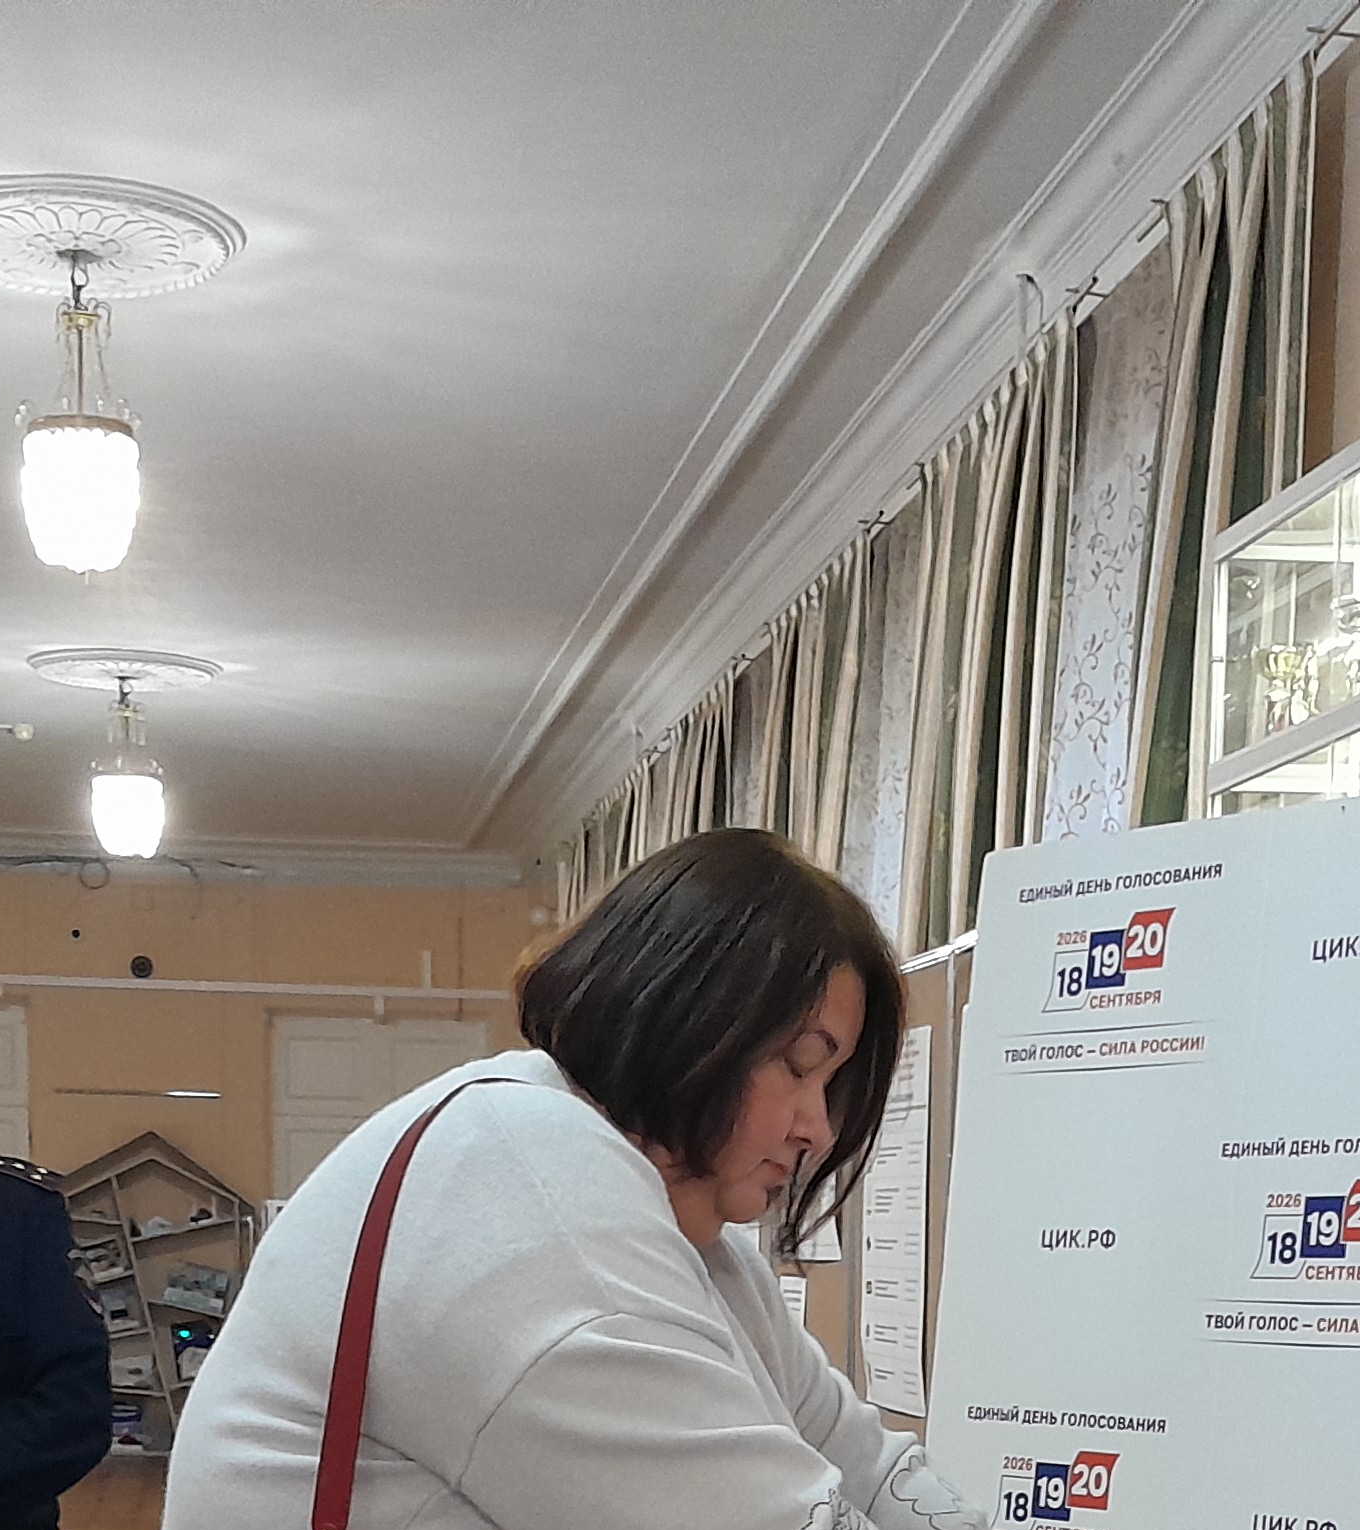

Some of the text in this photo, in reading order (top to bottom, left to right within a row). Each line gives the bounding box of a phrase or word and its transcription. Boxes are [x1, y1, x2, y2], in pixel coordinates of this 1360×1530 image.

[1019, 864, 1222, 903] ЕДИНЫЙ ДЕНЬ ГОЛОСОВАНИЯ
[1057, 930, 1087, 945] 2026
[1057, 923, 1164, 997] 18 19 20
[1090, 990, 1161, 1009] СЕНТЯБРЯ
[1005, 1045, 1036, 1062] ТВОЙ
[1041, 1045, 1083, 1060] ГОЛОС
[1099, 1041, 1136, 1056] СИЛА
[1141, 1037, 1204, 1052] РОССИИ!
[1221, 1138, 1285, 1159] ЕДИНЫЙ
[1289, 1140, 1330, 1156] ДЕНЬ
[1267, 1194, 1301, 1208] 2026
[1042, 1229, 1115, 1251] ЦИК.РФ
[1267, 1232, 1296, 1264] 18
[1307, 1211, 1338, 1246] 19
[1205, 1312, 1244, 1329] ТВОЙ
[1249, 1316, 1299, 1331] ГОЛОС
[1317, 1318, 1359, 1333] СИЛА
[968, 1406, 1166, 1433] ЕДИНЫЙ ДЕНЬ ГОЛОСОВАНИЯ
[1003, 1456, 1033, 1471] 2026
[1004, 1464, 1108, 1522] 18 19 20
